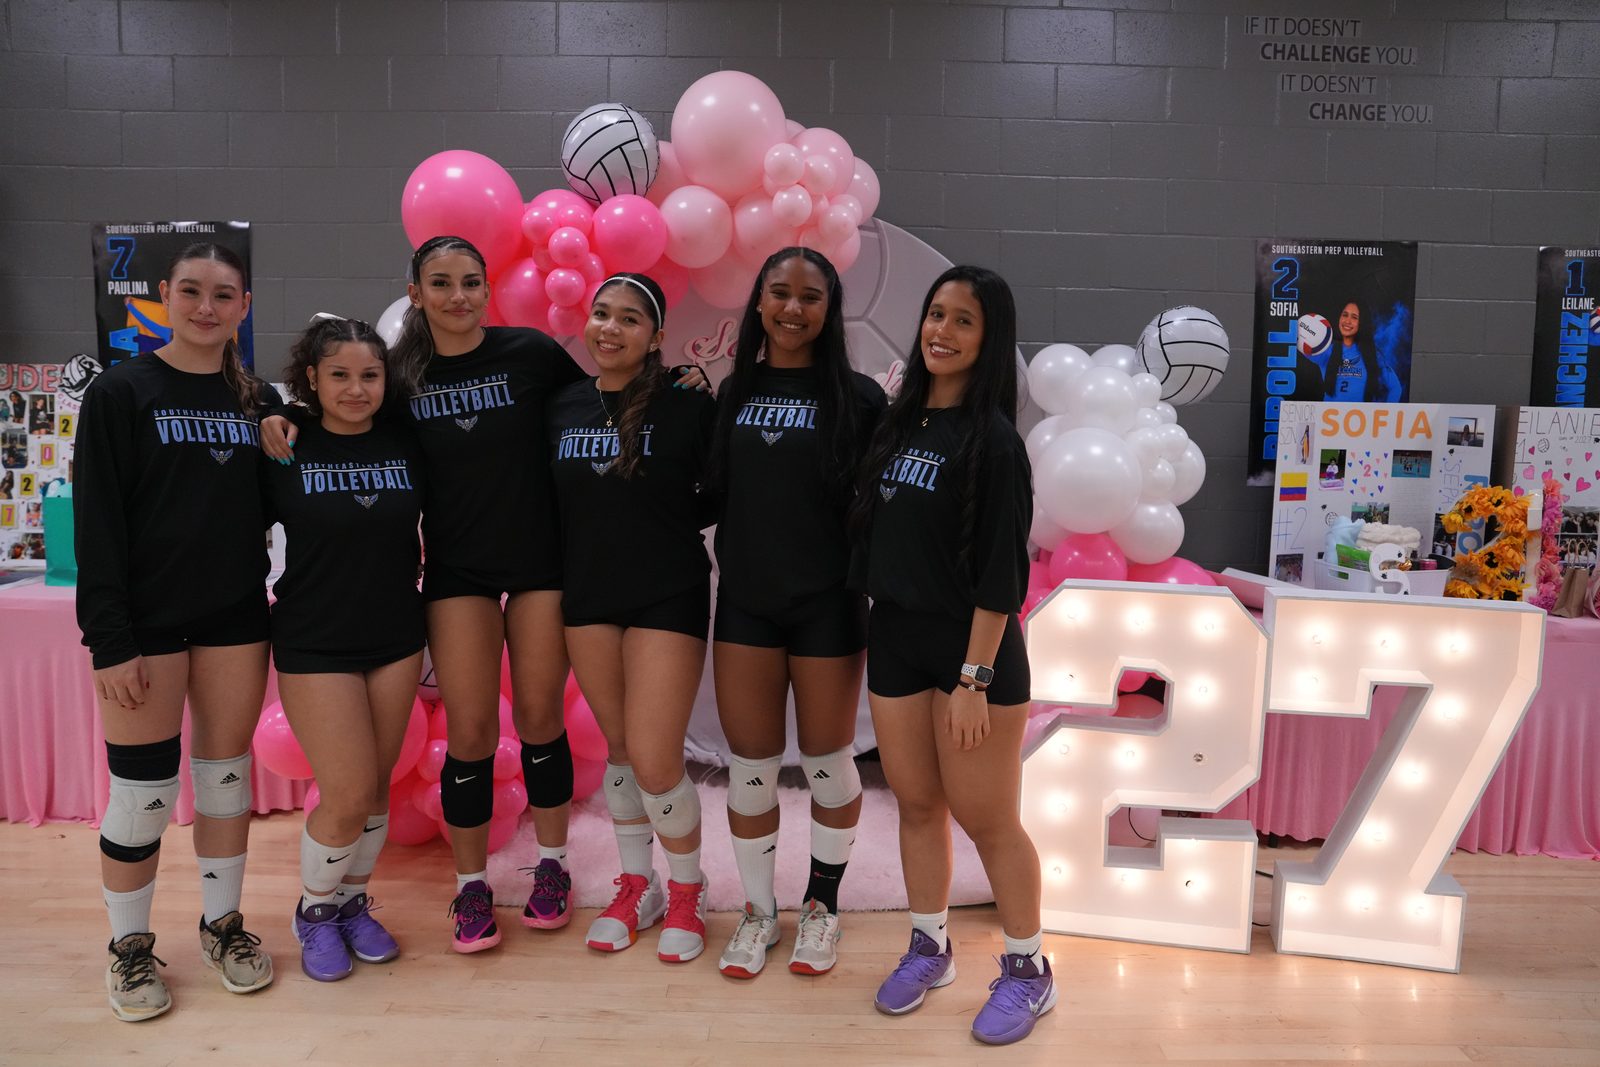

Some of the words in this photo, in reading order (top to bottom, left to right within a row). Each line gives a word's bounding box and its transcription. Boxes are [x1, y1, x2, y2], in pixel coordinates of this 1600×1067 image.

[1245, 17, 1259, 34] IF
[1264, 18, 1279, 35] IT
[1284, 18, 1361, 37] DOESN'T
[1260, 43, 1370, 64] CHALLENGE
[1376, 47, 1416, 66] YOU.
[1281, 74, 1296, 91] IT
[1301, 75, 1376, 93] DOESN'T
[1309, 103, 1386, 121] CHANGE
[1392, 105, 1432, 123] YOU.
[106, 225, 155, 234] SOUTHEASTERN
[156, 225, 173, 233] PREP
[175, 224, 216, 233] VOLLEYBALL
[106, 237, 136, 279] 7
[1272, 245, 1322, 255] SOUTHEASTERN
[1324, 245, 1341, 255] PREP
[1344, 246, 1384, 256] VOLLEYBALL
[108, 281, 149, 295] PAULINA
[1271, 257, 1299, 300] 2
[1566, 260, 1585, 296] 1
[1270, 301, 1298, 317] SOFIA
[1340, 381, 1349, 393] 2
[409, 384, 515, 421] VOLLEYBALL
[154, 408, 235, 419] SOUTHEASTERN
[736, 406, 816, 429] OLLEYBAL
[61, 418, 70, 434] 2
[1320, 408, 1433, 440] SOFIA
[1363, 464, 1372, 477] 2
[23, 477, 32, 492] 2
[302, 469, 413, 495] VOLLEYBALL
[1273, 507, 1308, 551] #2
